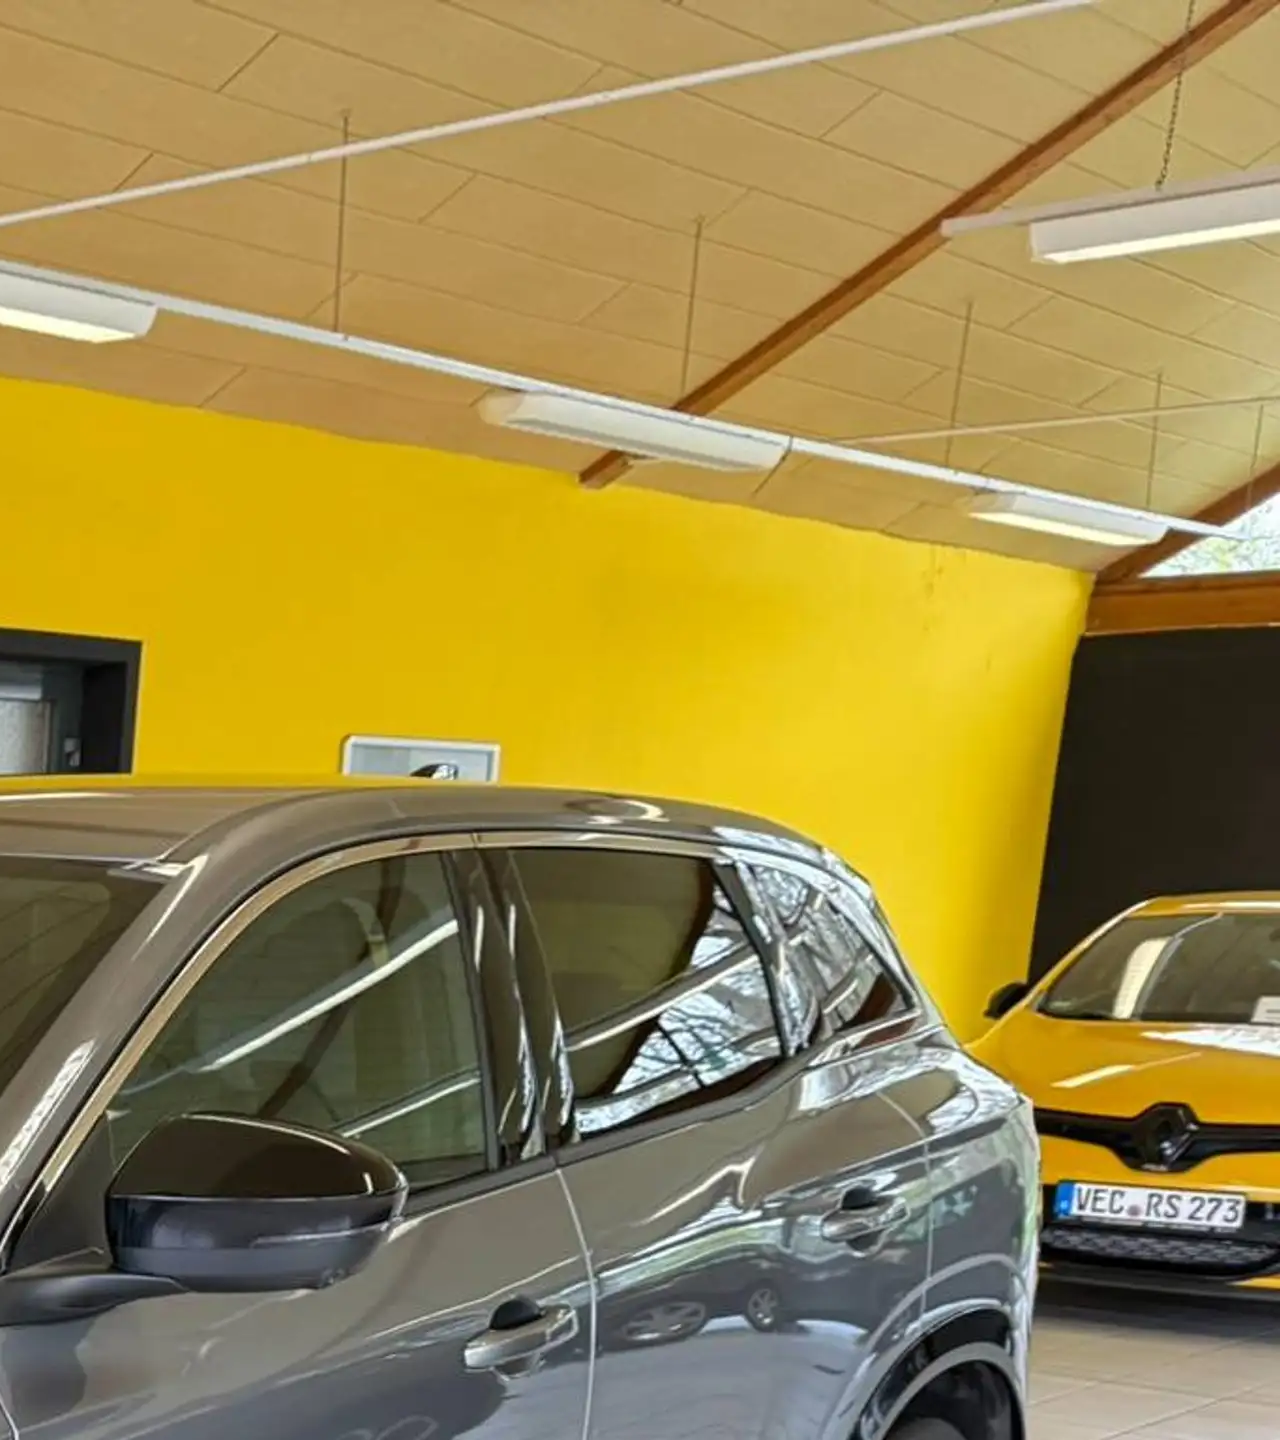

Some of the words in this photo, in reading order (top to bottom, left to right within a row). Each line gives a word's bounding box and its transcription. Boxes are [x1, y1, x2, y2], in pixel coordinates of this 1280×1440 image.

[1076, 1187, 1126, 1215] VEC
[1145, 1192, 1182, 1219] RS
[1187, 1197, 1240, 1223] 273
